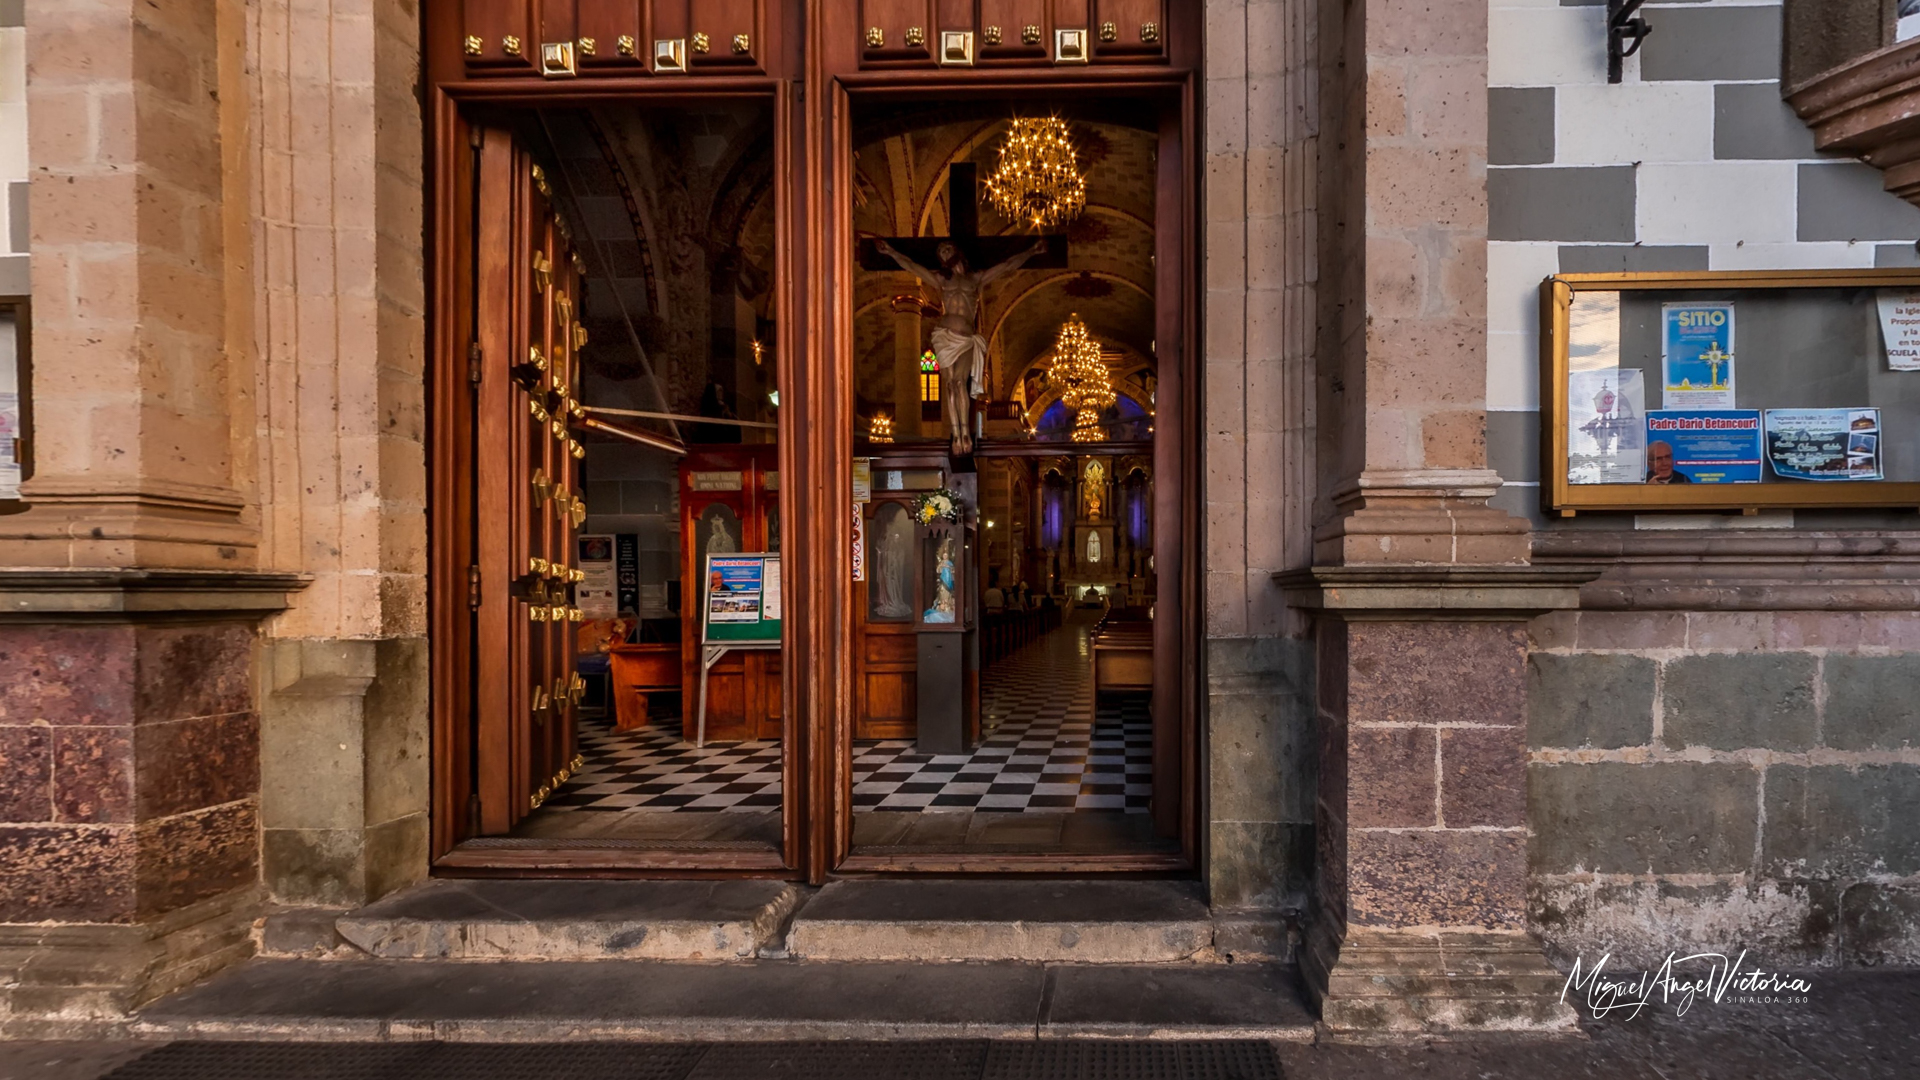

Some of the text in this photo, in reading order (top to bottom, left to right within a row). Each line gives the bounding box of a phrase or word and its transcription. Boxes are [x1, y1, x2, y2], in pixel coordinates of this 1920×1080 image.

[1678, 310, 1726, 327] SITIO
[1649, 418, 1677, 430] Padre
[1678, 417, 1704, 430] Dario
[1704, 417, 1758, 430] Betancourt
